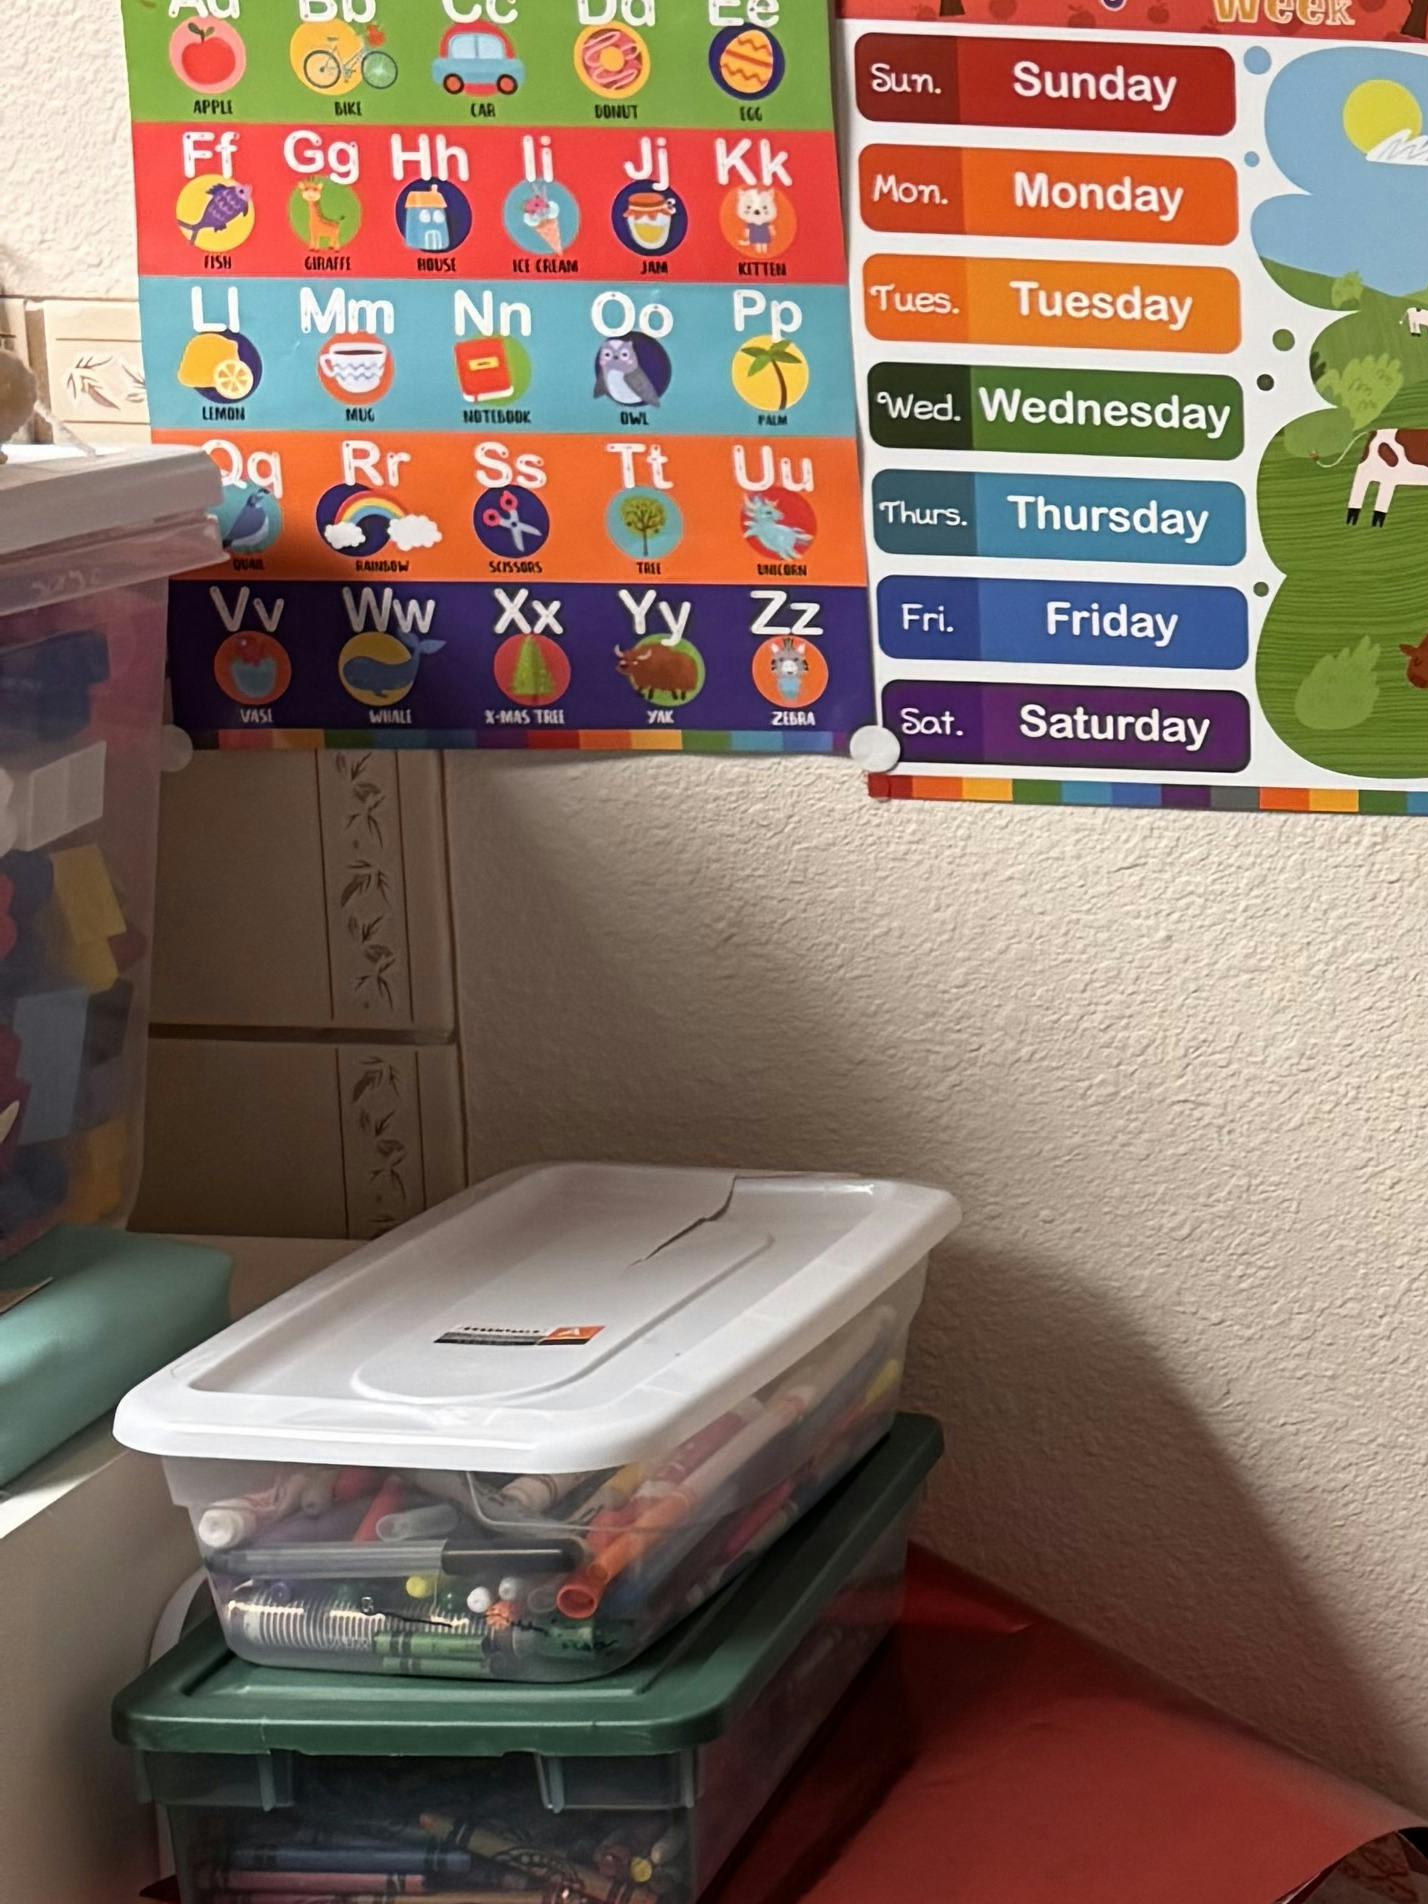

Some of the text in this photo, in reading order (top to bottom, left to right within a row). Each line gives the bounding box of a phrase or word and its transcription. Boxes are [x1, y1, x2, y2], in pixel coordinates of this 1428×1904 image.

[870, 64, 942, 94] Sun.
[1012, 61, 1178, 111] Sunday
[193, 100, 233, 114] APPLE
[594, 104, 638, 119] DONUT
[622, 136, 670, 191] Jj
[715, 138, 792, 186] Kk
[873, 174, 949, 205] Mon.
[1013, 170, 1184, 222] Monday
[869, 284, 959, 314] Tues.
[1009, 280, 1193, 331] Tuesday
[202, 406, 246, 421] LEMON
[877, 391, 961, 421] Wed.
[977, 386, 1231, 439] Wednesday
[342, 440, 410, 486] Rr
[879, 501, 967, 527] Thurs.
[1006, 494, 1209, 543] Thursday
[618, 589, 691, 646] Yy
[750, 590, 823, 637] Zz
[901, 604, 954, 632] Fri.
[1046, 600, 1179, 646] Friday
[899, 708, 963, 736] Sat.
[1019, 704, 1211, 751] Saturday
